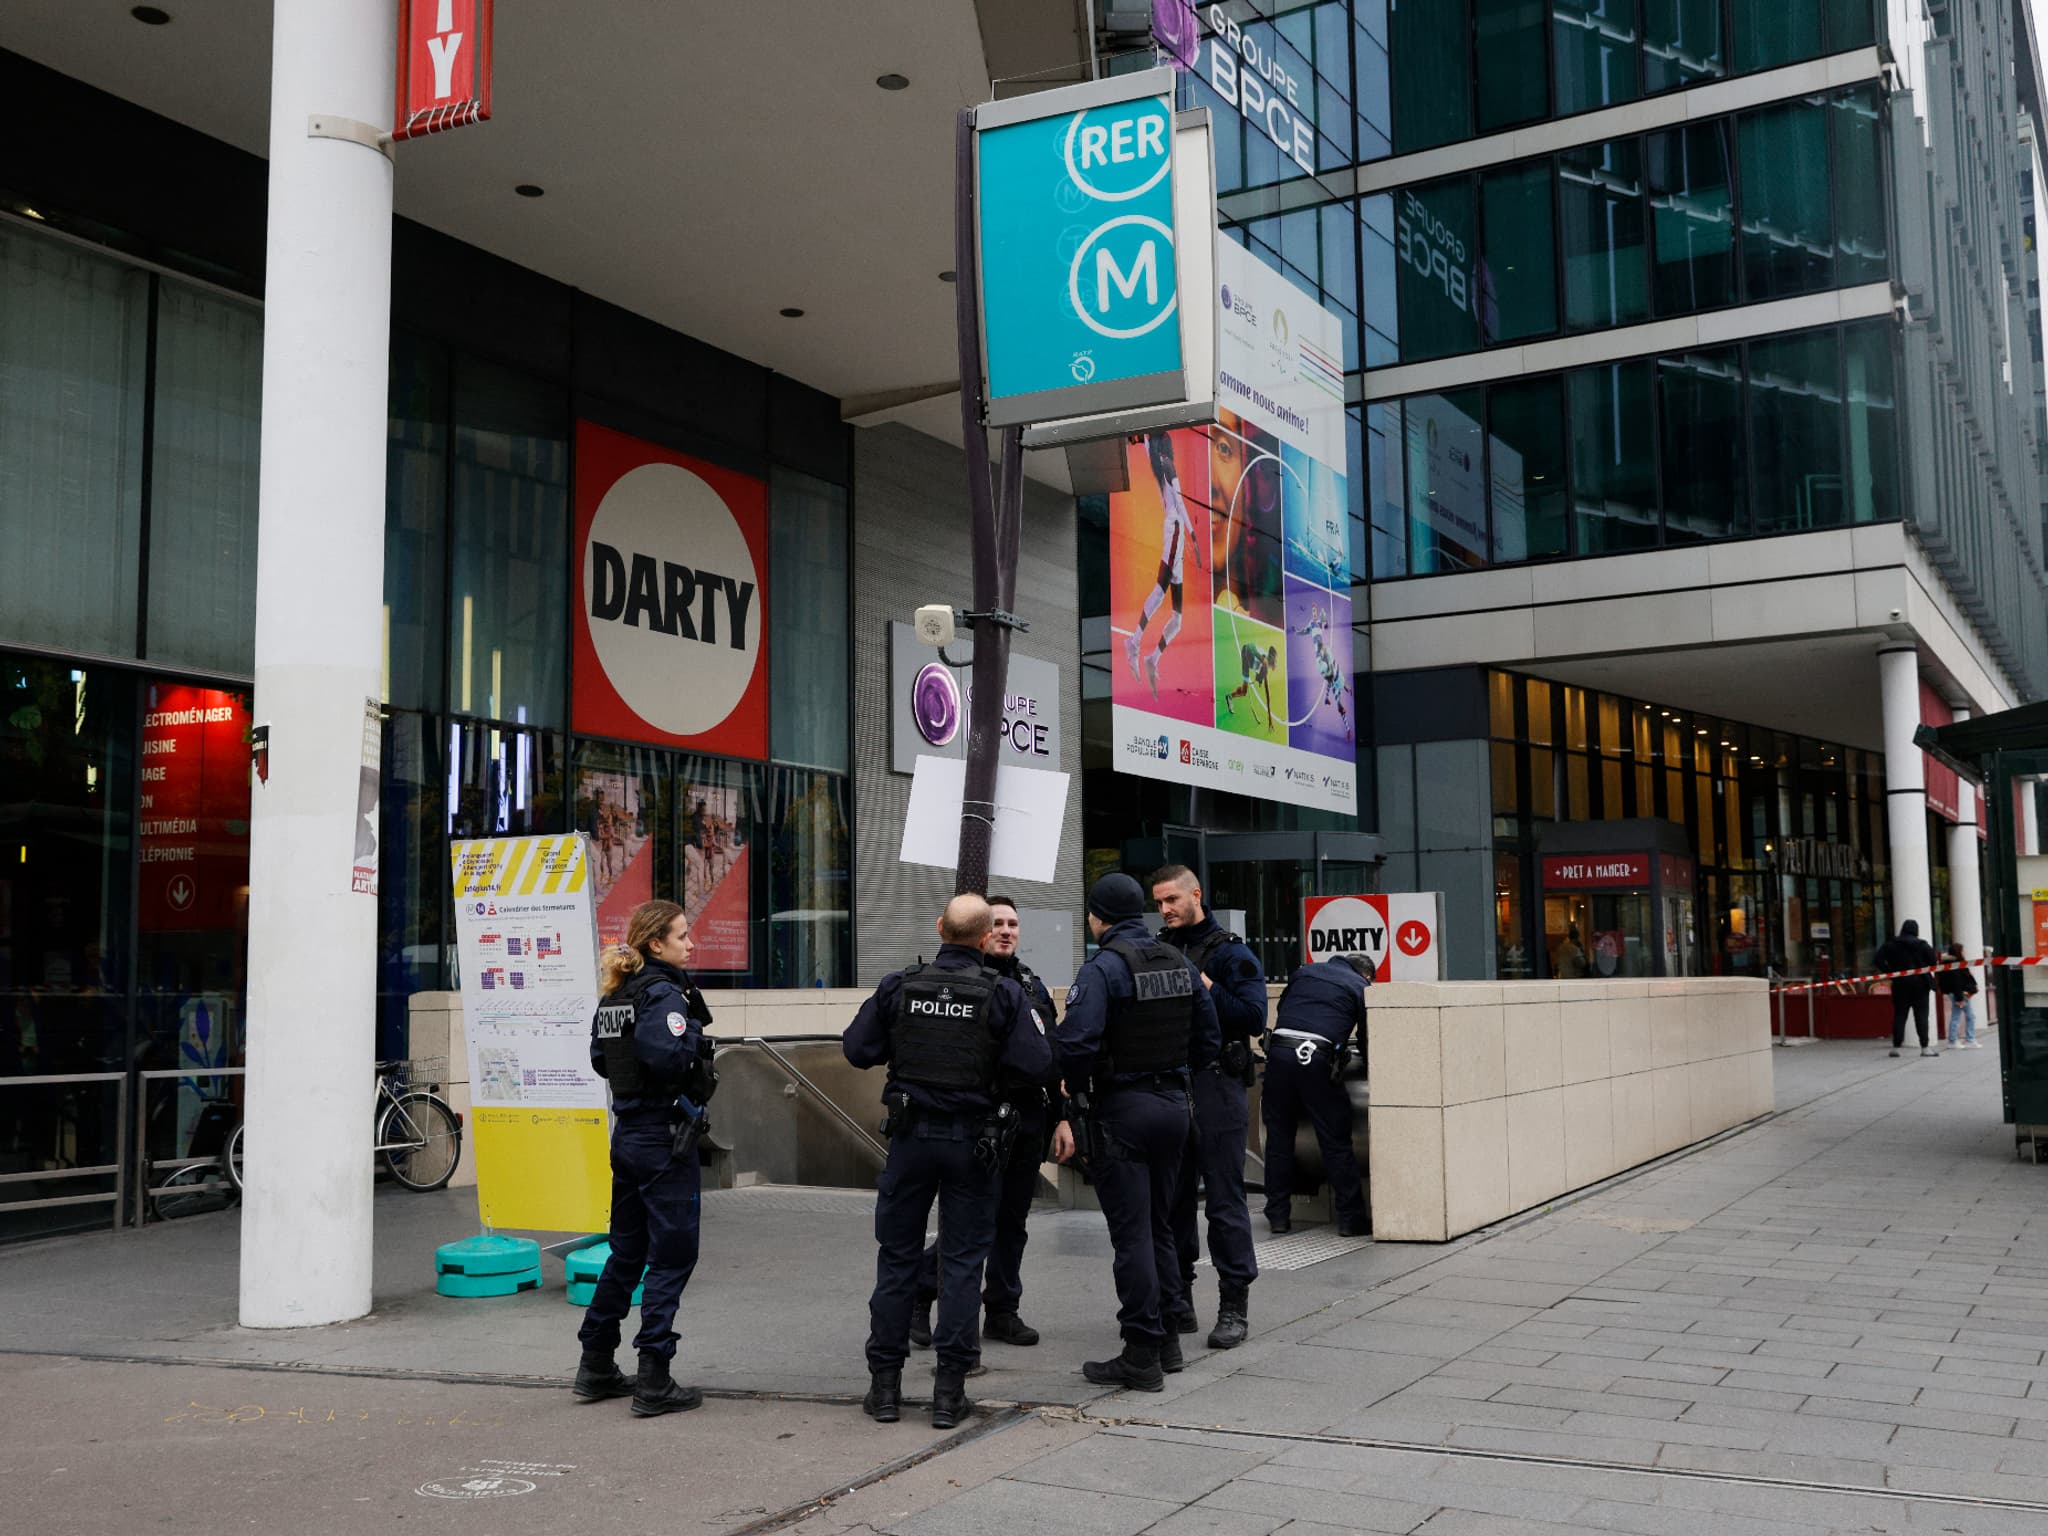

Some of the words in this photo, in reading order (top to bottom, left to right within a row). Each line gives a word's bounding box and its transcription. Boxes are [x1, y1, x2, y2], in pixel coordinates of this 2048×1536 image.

[1210, 3, 1299, 107] GROUPE
[1211, 39, 1315, 177] BPCE
[1081, 114, 1165, 169] RER
[1096, 240, 1158, 313] M
[1234, 304, 1258, 328] BPCE
[1252, 391, 1276, 415] nous
[592, 540, 755, 651] DARTY
[1562, 865, 1584, 879] PRET
[1586, 866, 1593, 878] A
[1596, 864, 1631, 878] MANGER
[1311, 927, 1384, 952] DARTY
[1140, 971, 1192, 997] POLICE
[911, 1000, 973, 1018] POLICE
